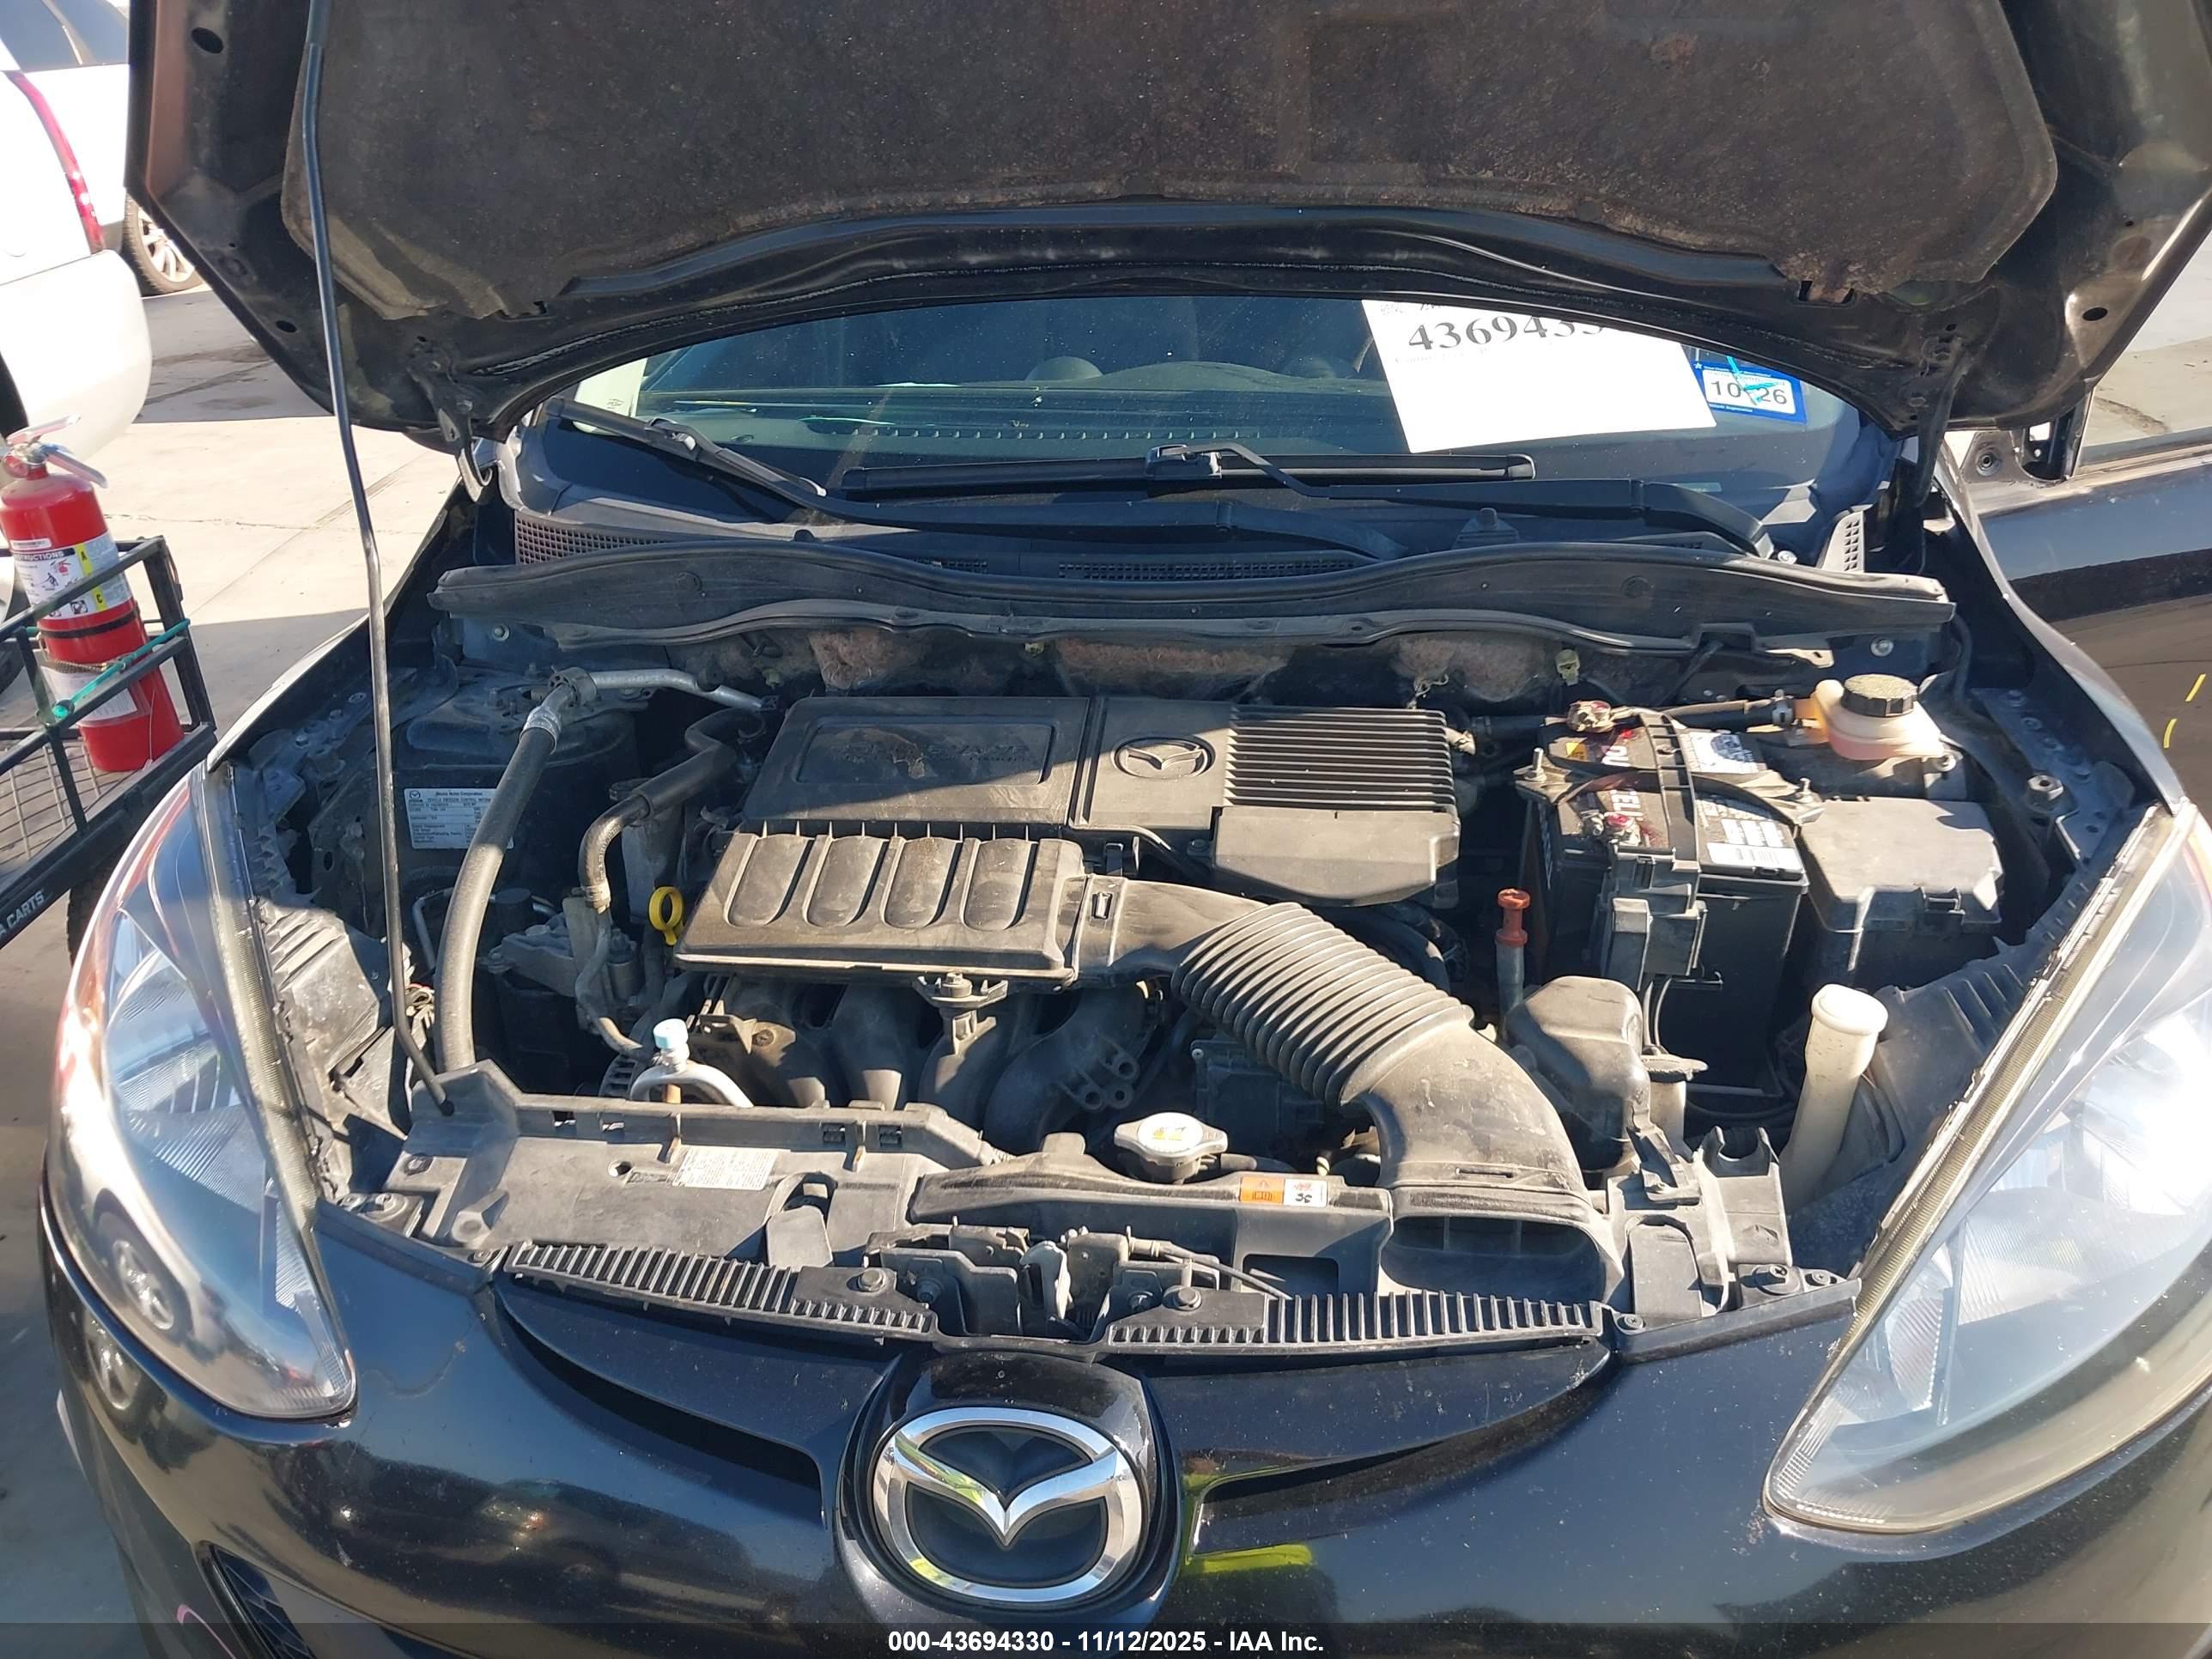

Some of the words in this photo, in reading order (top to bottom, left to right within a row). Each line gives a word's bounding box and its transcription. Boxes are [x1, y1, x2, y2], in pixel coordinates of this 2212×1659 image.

[1711, 380, 1741, 398] 10
[1757, 386, 1787, 404] 26
[6, 890, 45, 929] CARTS
